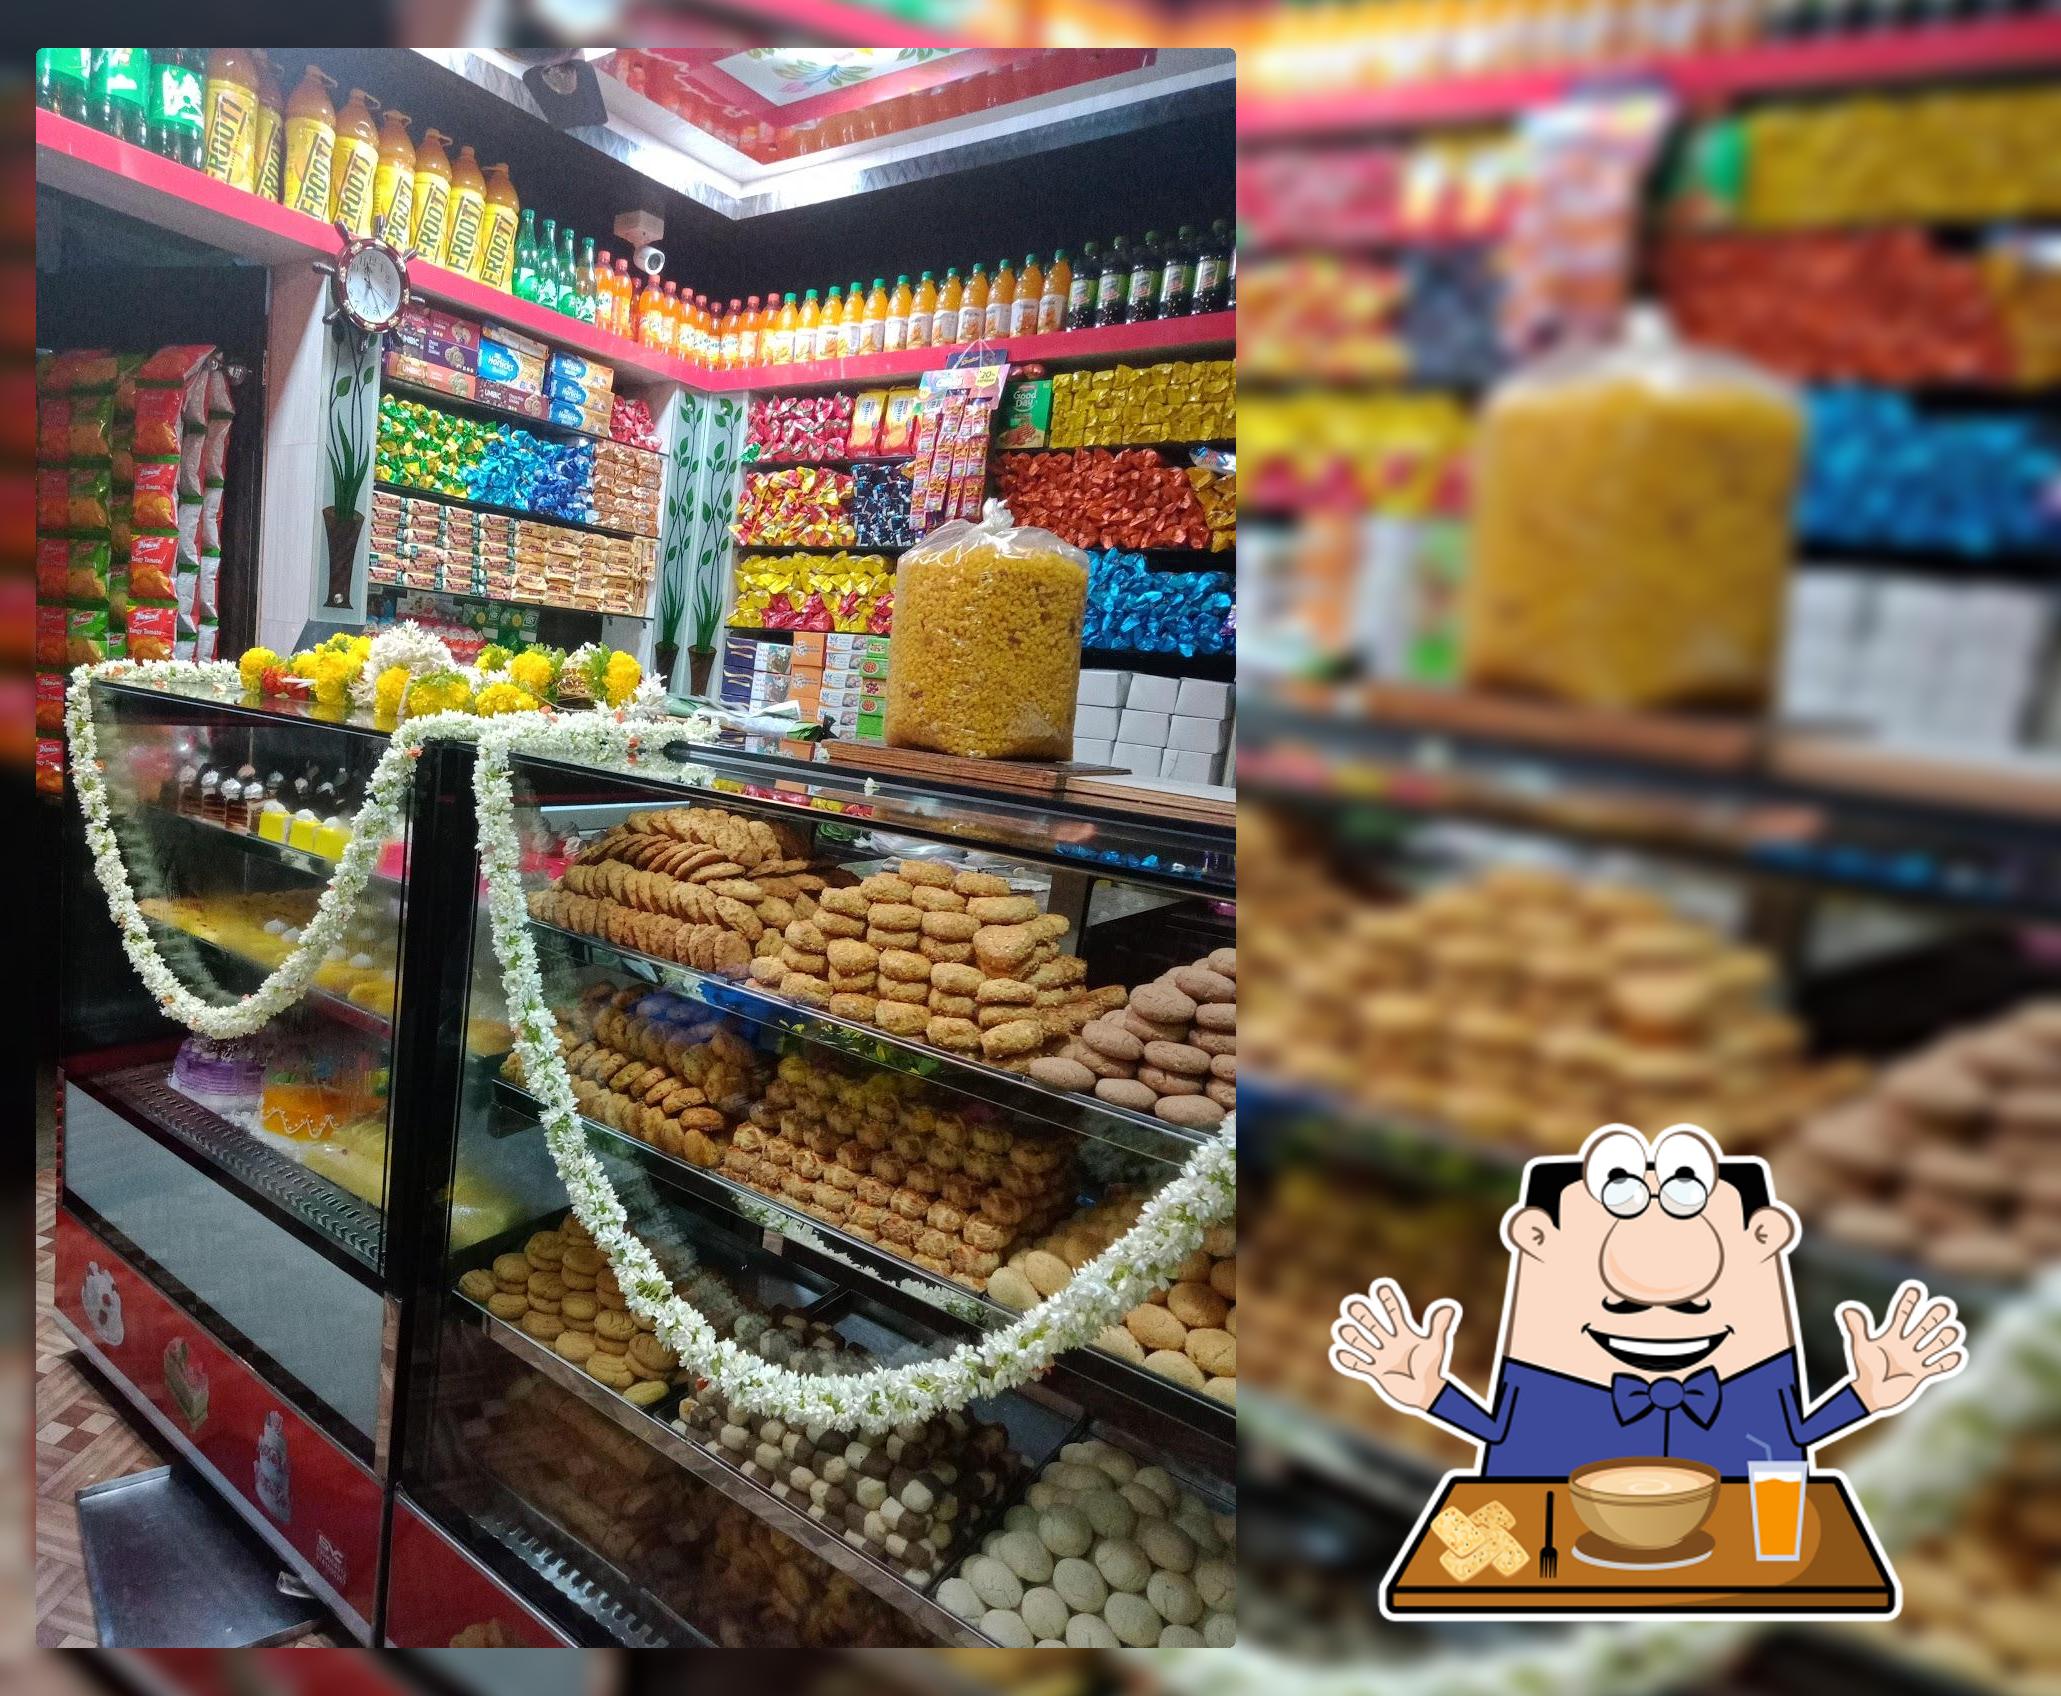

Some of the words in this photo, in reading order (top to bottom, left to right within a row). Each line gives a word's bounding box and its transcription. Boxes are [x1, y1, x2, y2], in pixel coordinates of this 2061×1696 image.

[207, 97, 243, 177] ROOTI
[299, 136, 333, 218] FROOTI
[417, 186, 447, 257] FROOTI
[447, 198, 481, 271] FROOTI
[482, 215, 515, 286] FROOTI
[488, 355, 515, 371] Horlicks
[1013, 389, 1037, 400] Good
[1016, 399, 1034, 408] Day
